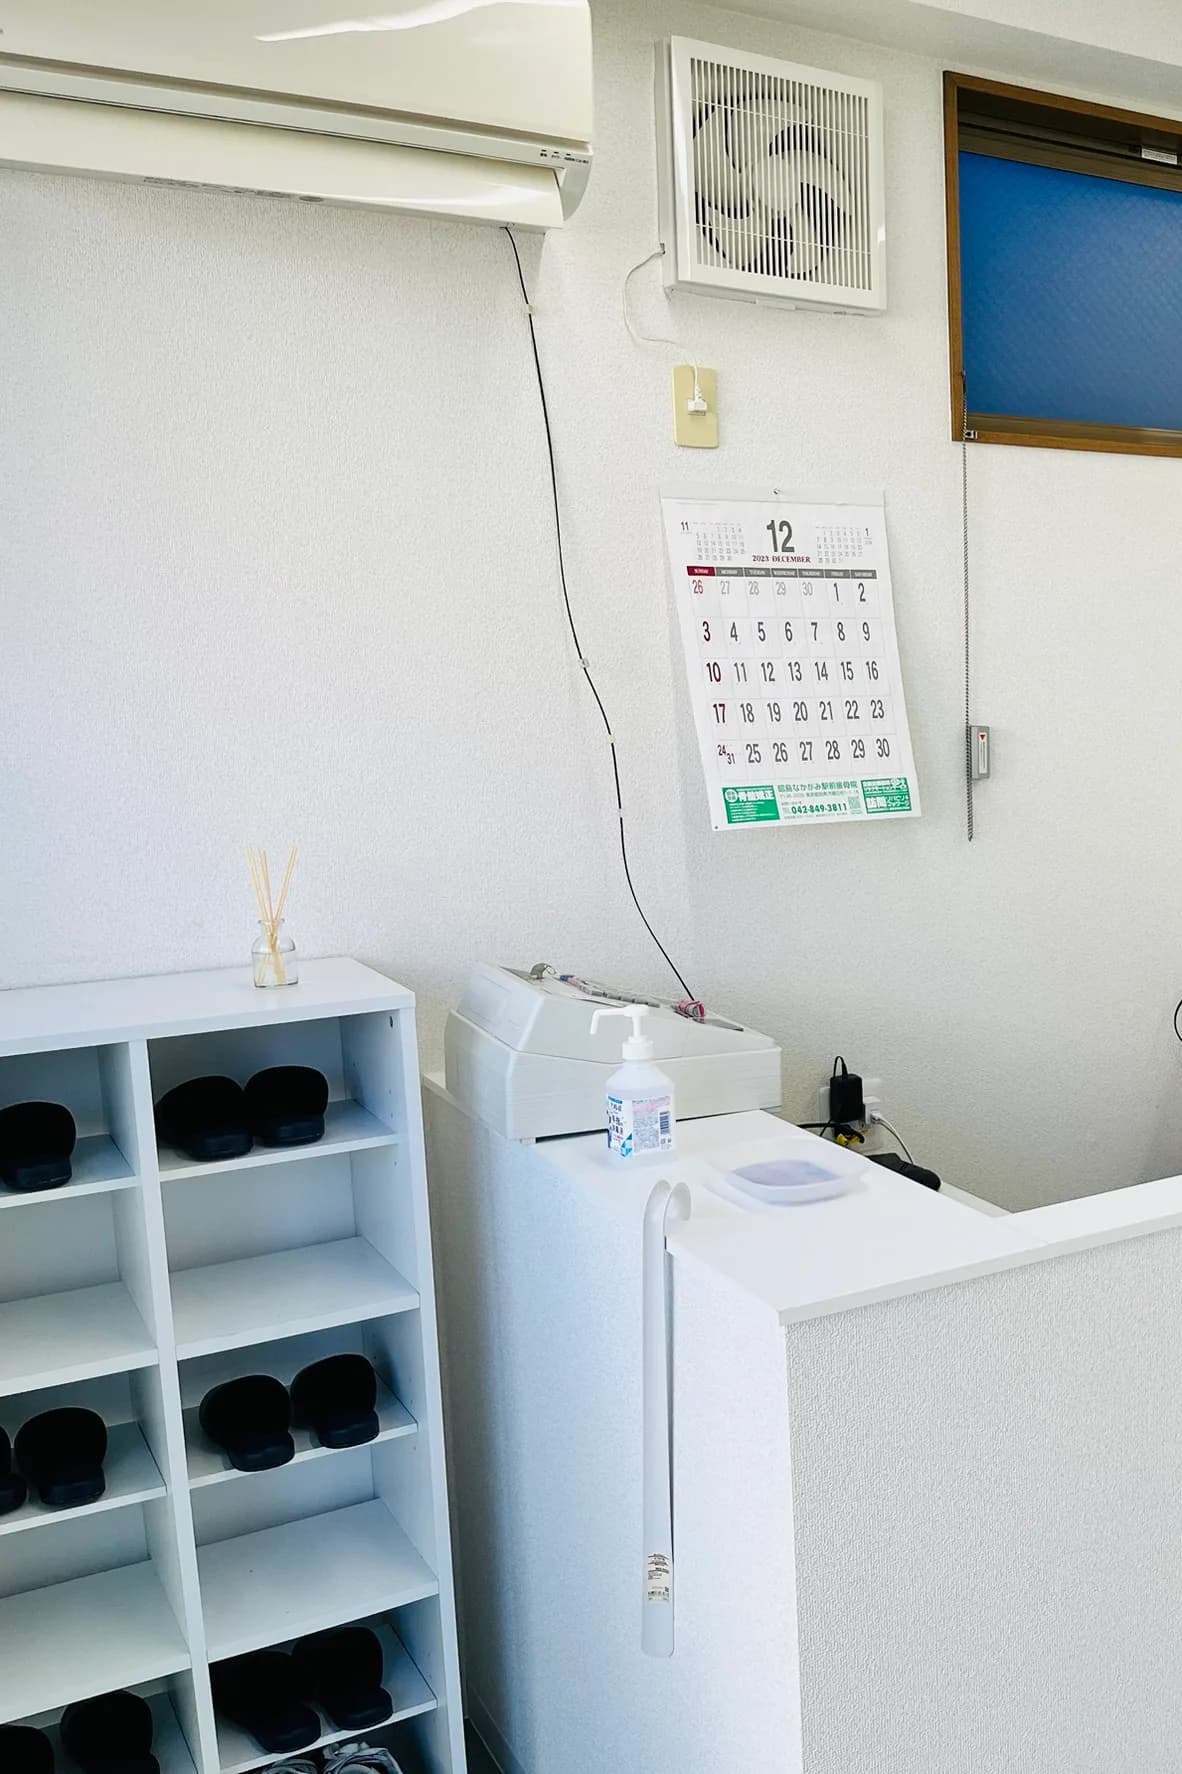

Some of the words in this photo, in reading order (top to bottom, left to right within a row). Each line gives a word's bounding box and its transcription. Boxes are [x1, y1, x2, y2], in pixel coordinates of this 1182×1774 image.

[680, 521, 690, 532] 11
[766, 520, 795, 553] 12
[752, 554, 770, 562] 2023
[772, 555, 811, 563] DECEMBER
[691, 580, 704, 594] 26
[719, 581, 731, 594] 27
[747, 581, 759, 595] 28
[775, 582, 786, 595] 29
[802, 582, 814, 595] 30
[832, 583, 840, 602] 1
[857, 582, 867, 602] 2
[702, 621, 711, 642] 3
[729, 622, 738, 642] 4
[757, 622, 766, 642] 5
[784, 621, 793, 642] 6
[810, 622, 818, 641] 7
[836, 622, 845, 641] 8
[862, 622, 870, 641] 9
[705, 662, 721, 682] 10
[733, 662, 747, 682] 11
[760, 662, 776, 682] 12
[787, 661, 802, 681] 13
[814, 661, 828, 681] 14
[839, 661, 854, 680] 15
[865, 661, 878, 680] 16
[712, 703, 725, 724] 17
[739, 703, 755, 723] 18
[766, 702, 781, 722] 19
[792, 701, 808, 721] 20
[818, 701, 833, 720] 21
[844, 700, 860, 719] 22
[869, 700, 884, 719] 23
[746, 744, 761, 763] 25
[773, 742, 788, 762] 26
[800, 741, 812, 761] 27
[825, 740, 840, 760] 28
[851, 739, 865, 758] 29
[876, 738, 890, 758] 30
